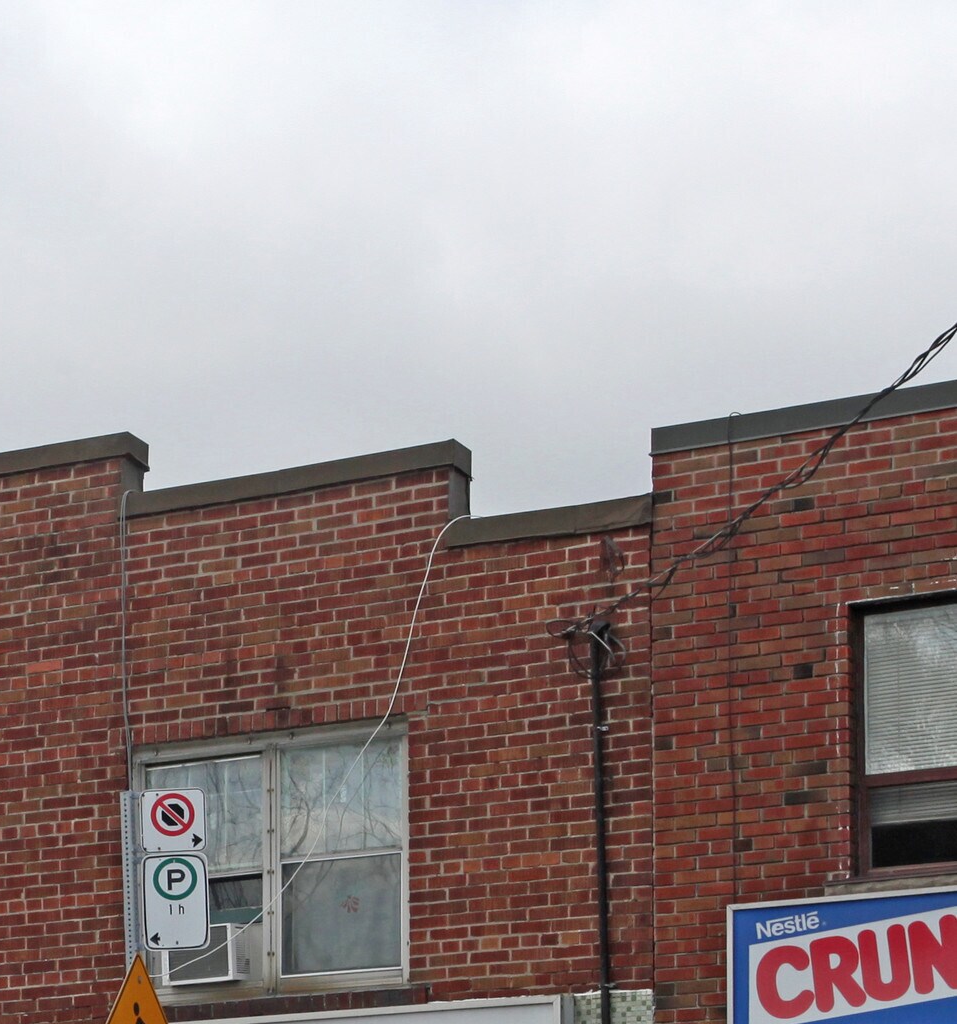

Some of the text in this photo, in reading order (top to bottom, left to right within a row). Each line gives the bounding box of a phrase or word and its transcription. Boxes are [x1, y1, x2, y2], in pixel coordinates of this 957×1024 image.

[166, 868, 186, 891] P
[169, 903, 185, 916] 1 h
